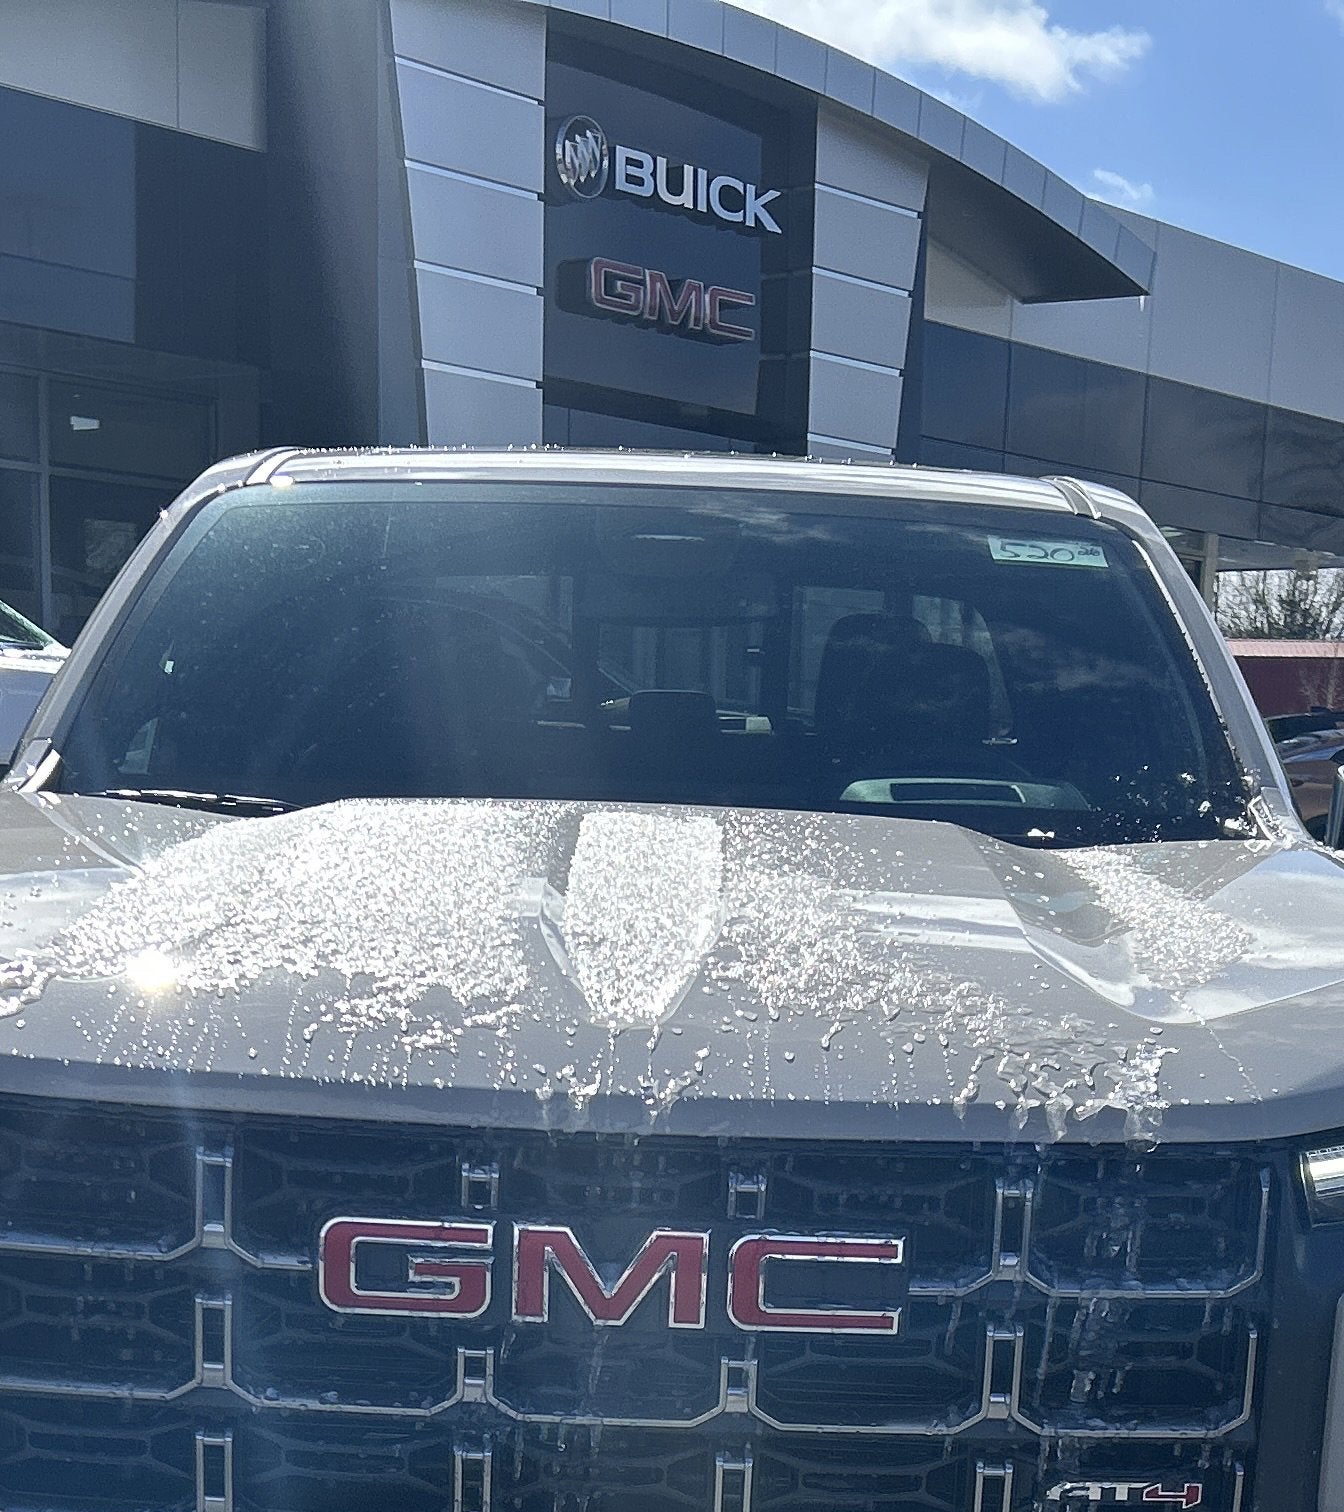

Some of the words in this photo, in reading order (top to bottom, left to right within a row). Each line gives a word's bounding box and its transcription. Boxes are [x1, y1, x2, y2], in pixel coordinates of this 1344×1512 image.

[615, 144, 782, 234] BUICK
[590, 256, 756, 341] GMC
[999, 541, 1075, 561] 520
[318, 1217, 904, 1335] GMC
[1046, 1482, 1203, 1509] AT4
